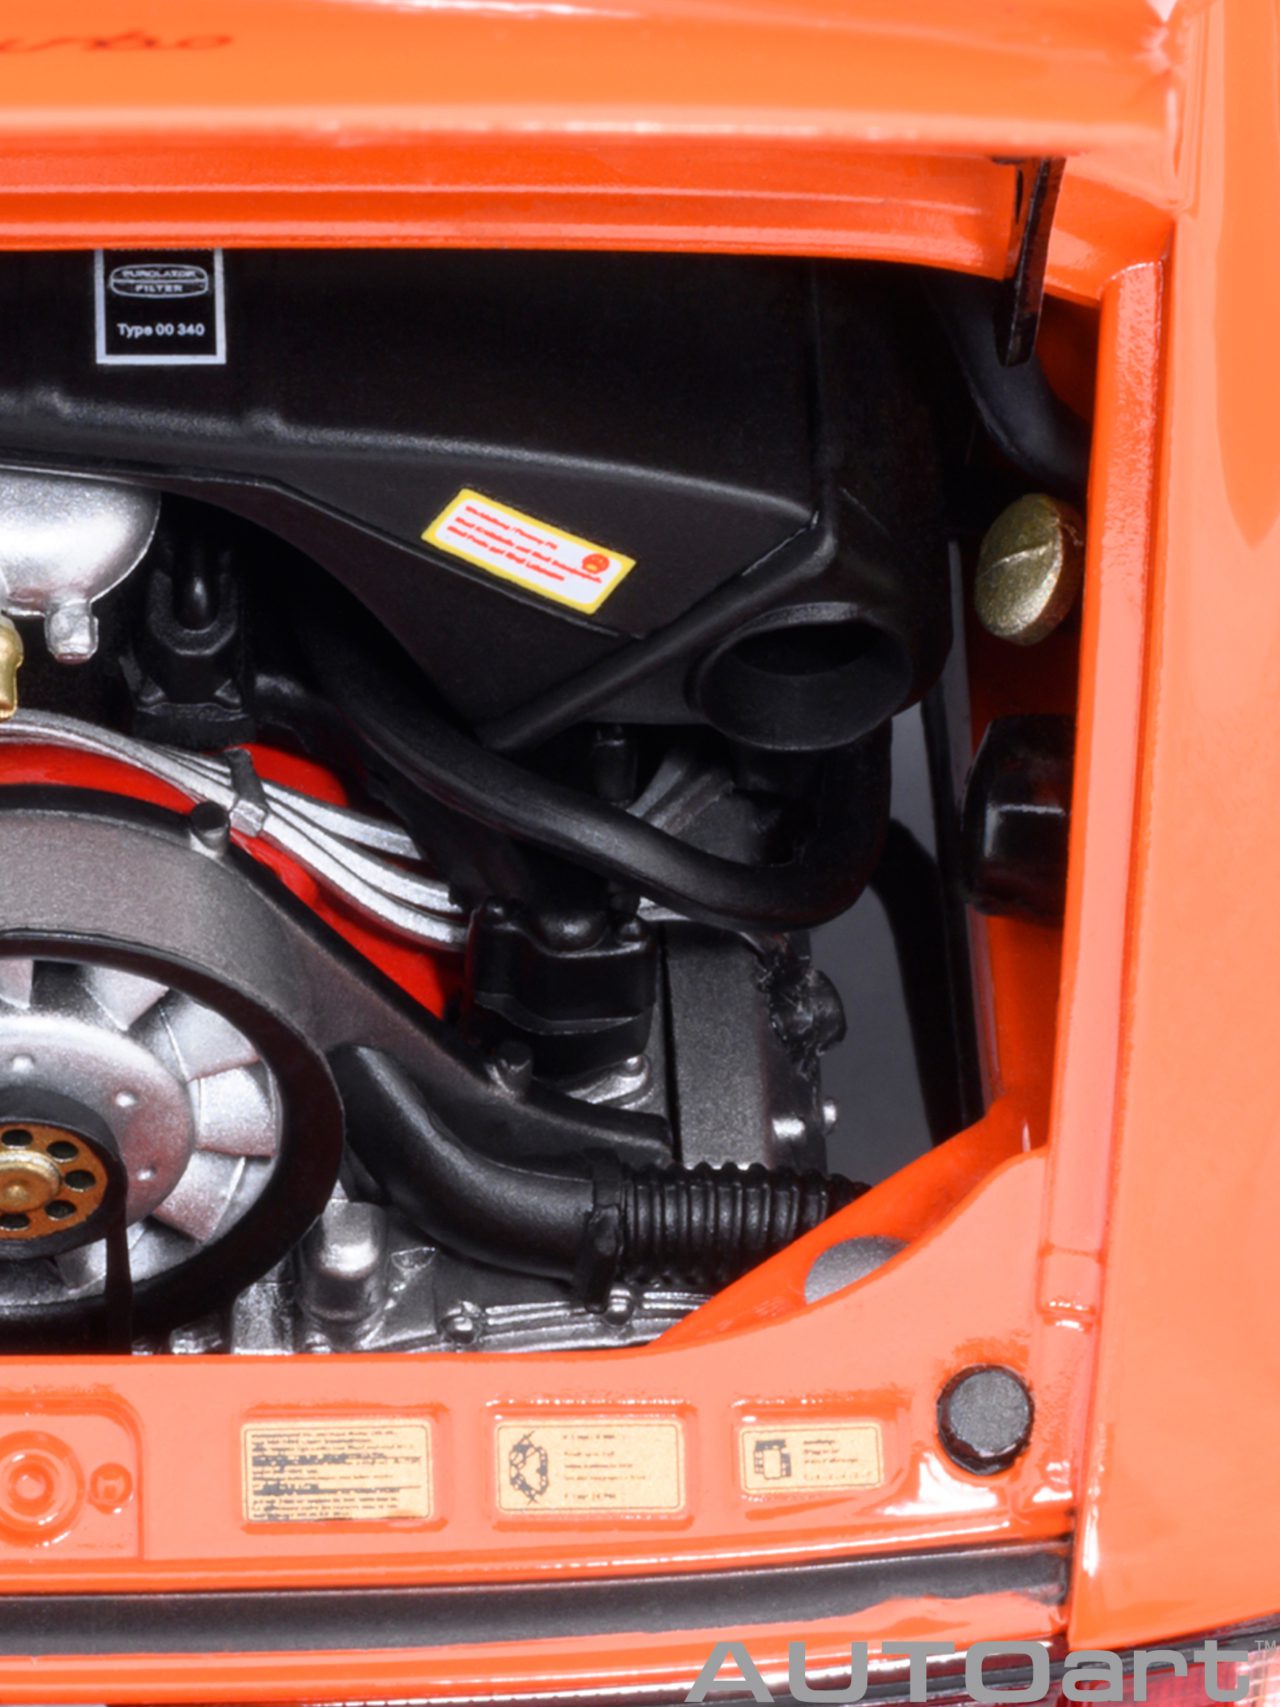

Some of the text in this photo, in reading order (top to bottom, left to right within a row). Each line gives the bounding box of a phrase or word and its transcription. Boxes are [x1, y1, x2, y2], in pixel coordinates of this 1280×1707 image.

[135, 284, 183, 293] FILTER
[117, 322, 205, 339] Type 00 340
